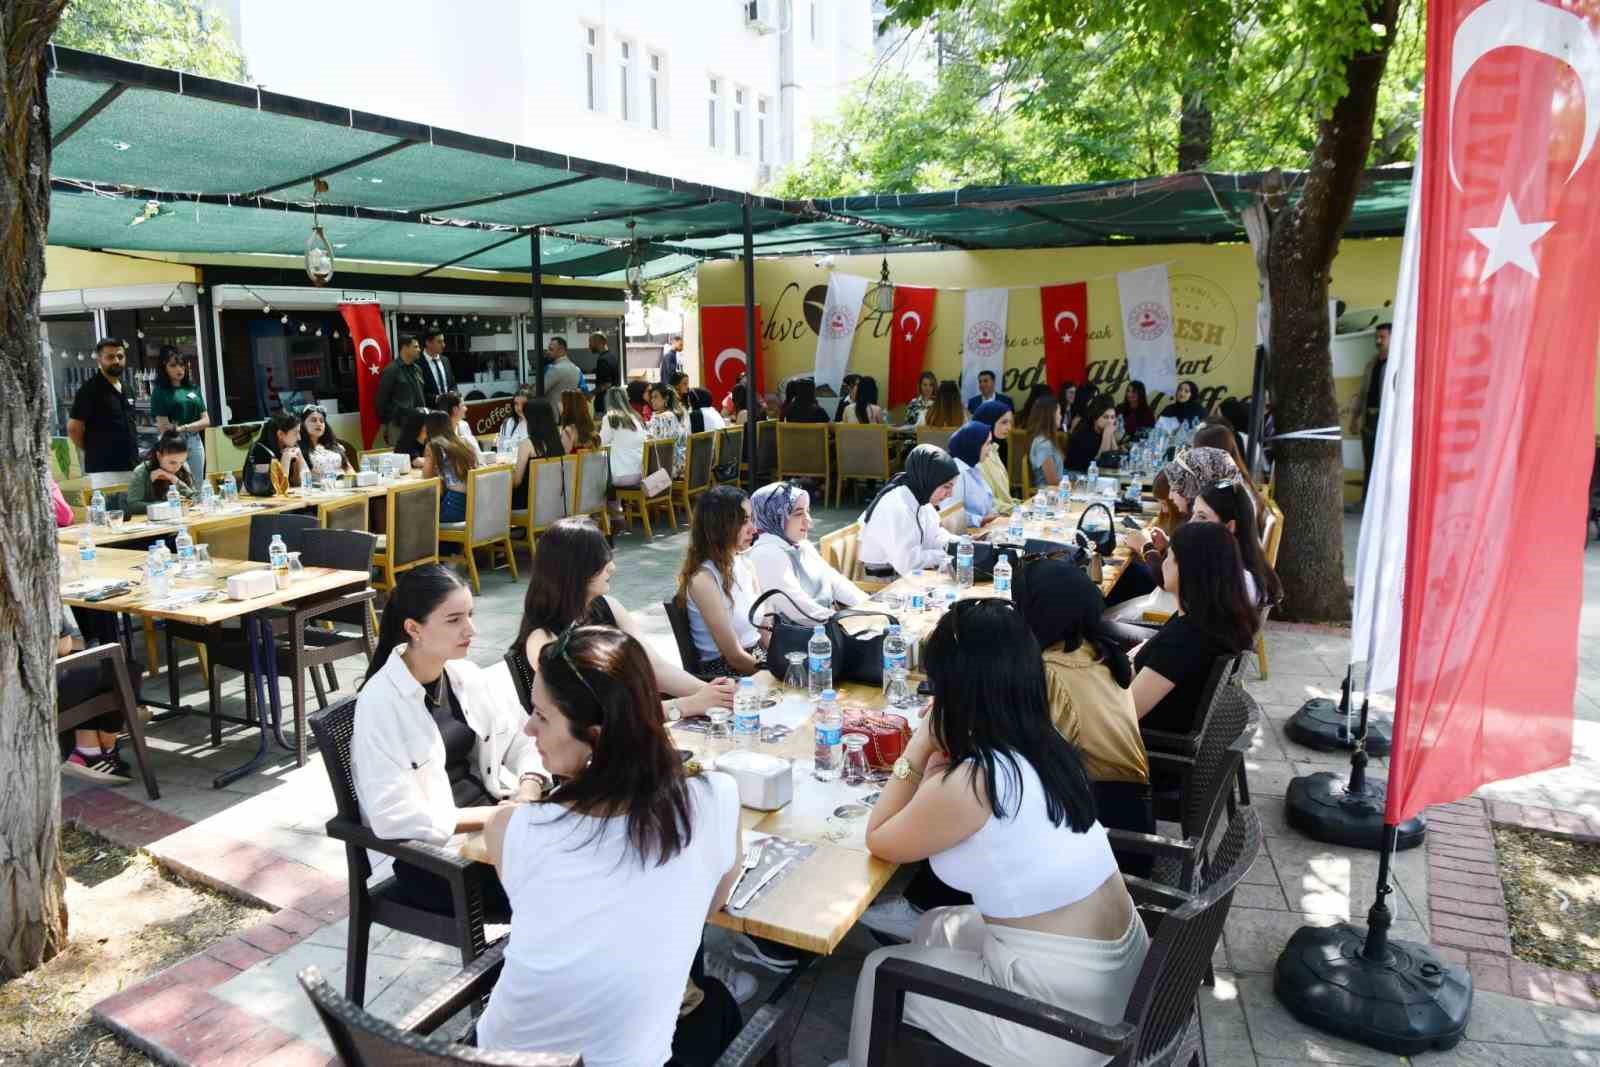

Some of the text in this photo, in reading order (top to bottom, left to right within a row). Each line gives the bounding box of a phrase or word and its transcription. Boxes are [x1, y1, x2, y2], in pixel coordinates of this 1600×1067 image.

[761, 282, 807, 342] hve
[1174, 318, 1225, 346] ESH
[1003, 357, 1048, 393] od
[1175, 354, 1214, 375] tart
[476, 403, 513, 434] Coffee
